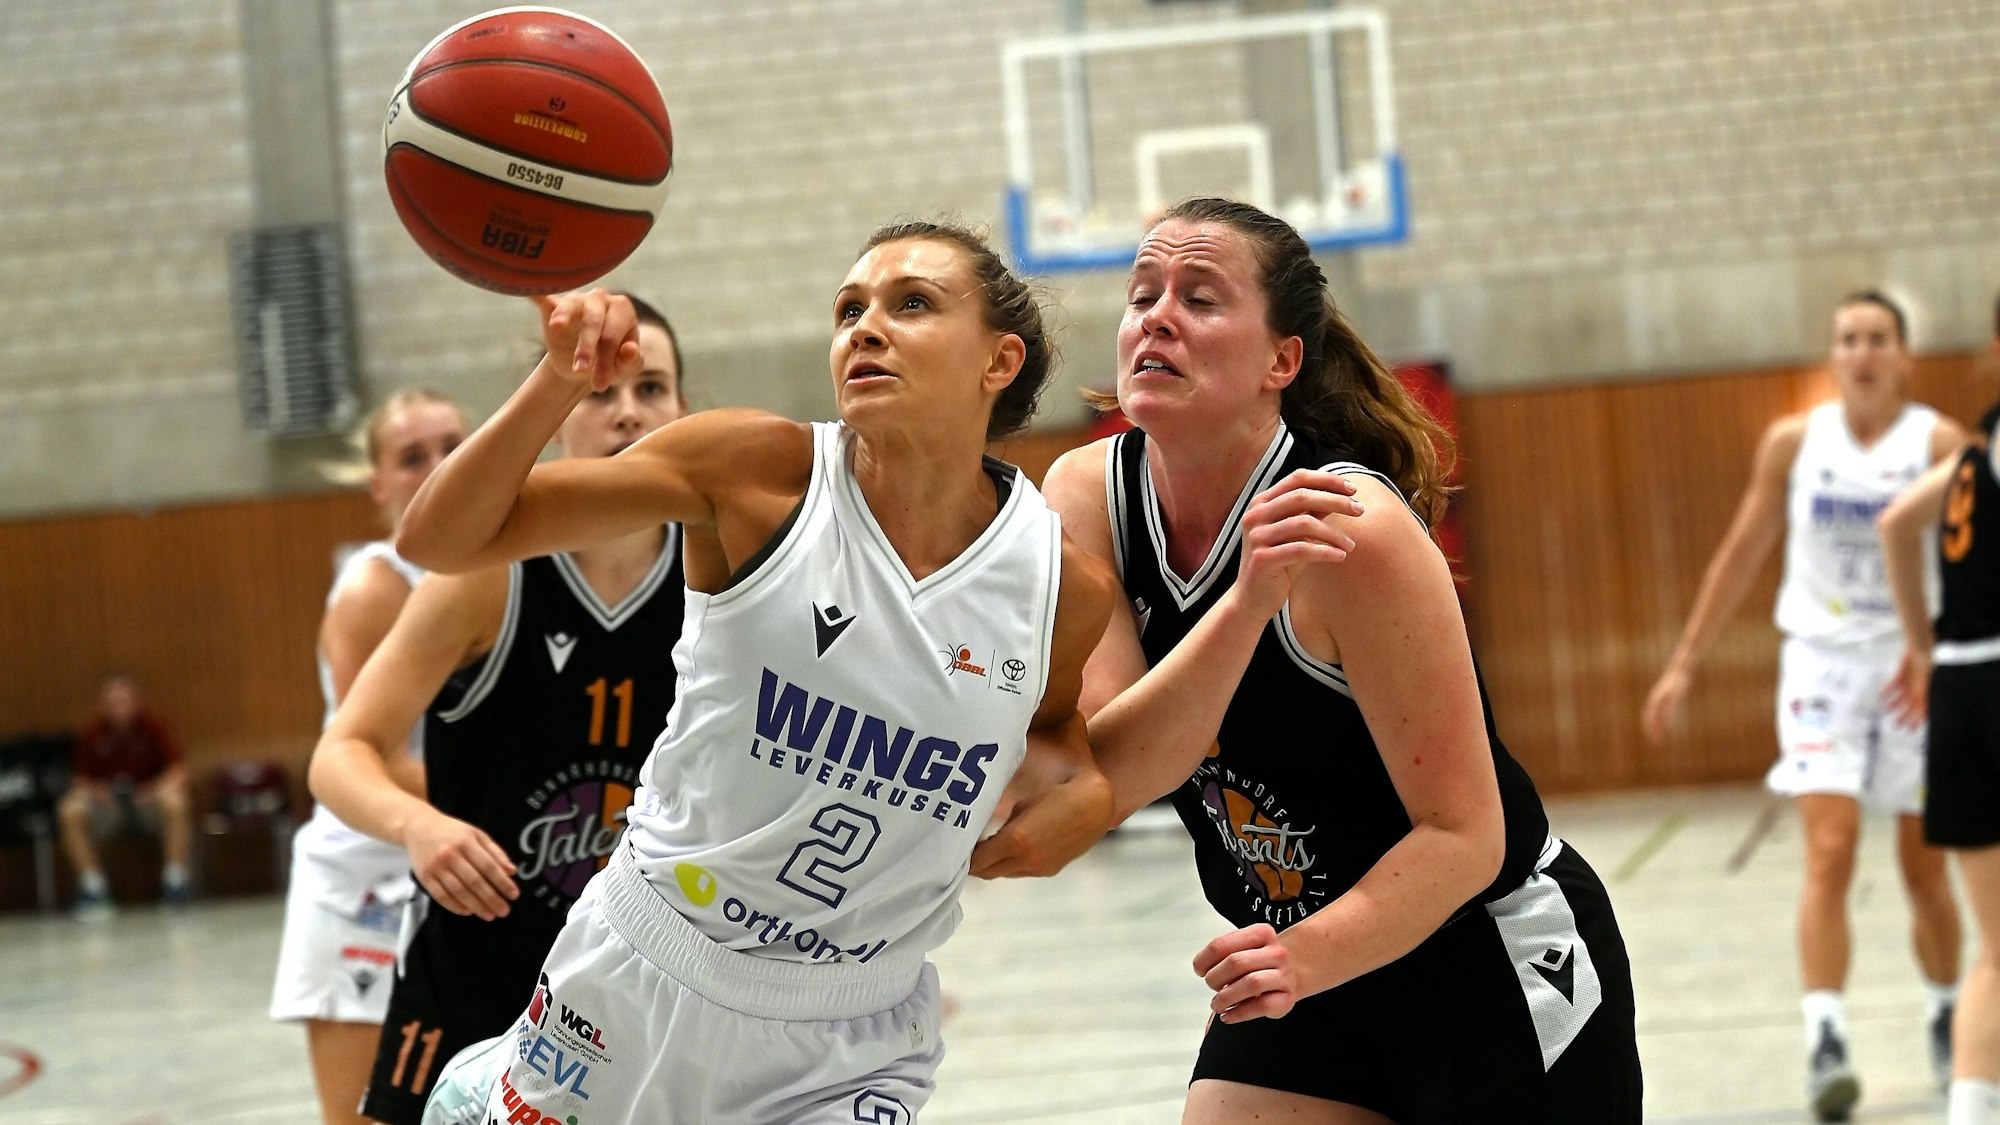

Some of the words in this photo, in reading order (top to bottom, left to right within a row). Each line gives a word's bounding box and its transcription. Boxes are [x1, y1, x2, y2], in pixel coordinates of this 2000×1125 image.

[514, 113, 588, 143] COMPETITION
[507, 162, 563, 190] BG4550
[481, 224, 545, 259] FIBA
[952, 660, 986, 677] DBBL
[585, 677, 634, 747] 11
[755, 666, 999, 806] WINGS
[749, 738, 971, 829] LEVERKUSEN
[517, 803, 629, 880] Tale
[775, 802, 882, 910] 2
[554, 1023, 612, 1065] Wohnungsgesellschaft
[560, 1003, 606, 1050] WGL
[391, 1020, 443, 1095] 11
[526, 1035, 590, 1100] EVL
[580, 1049, 599, 1065] GmbH
